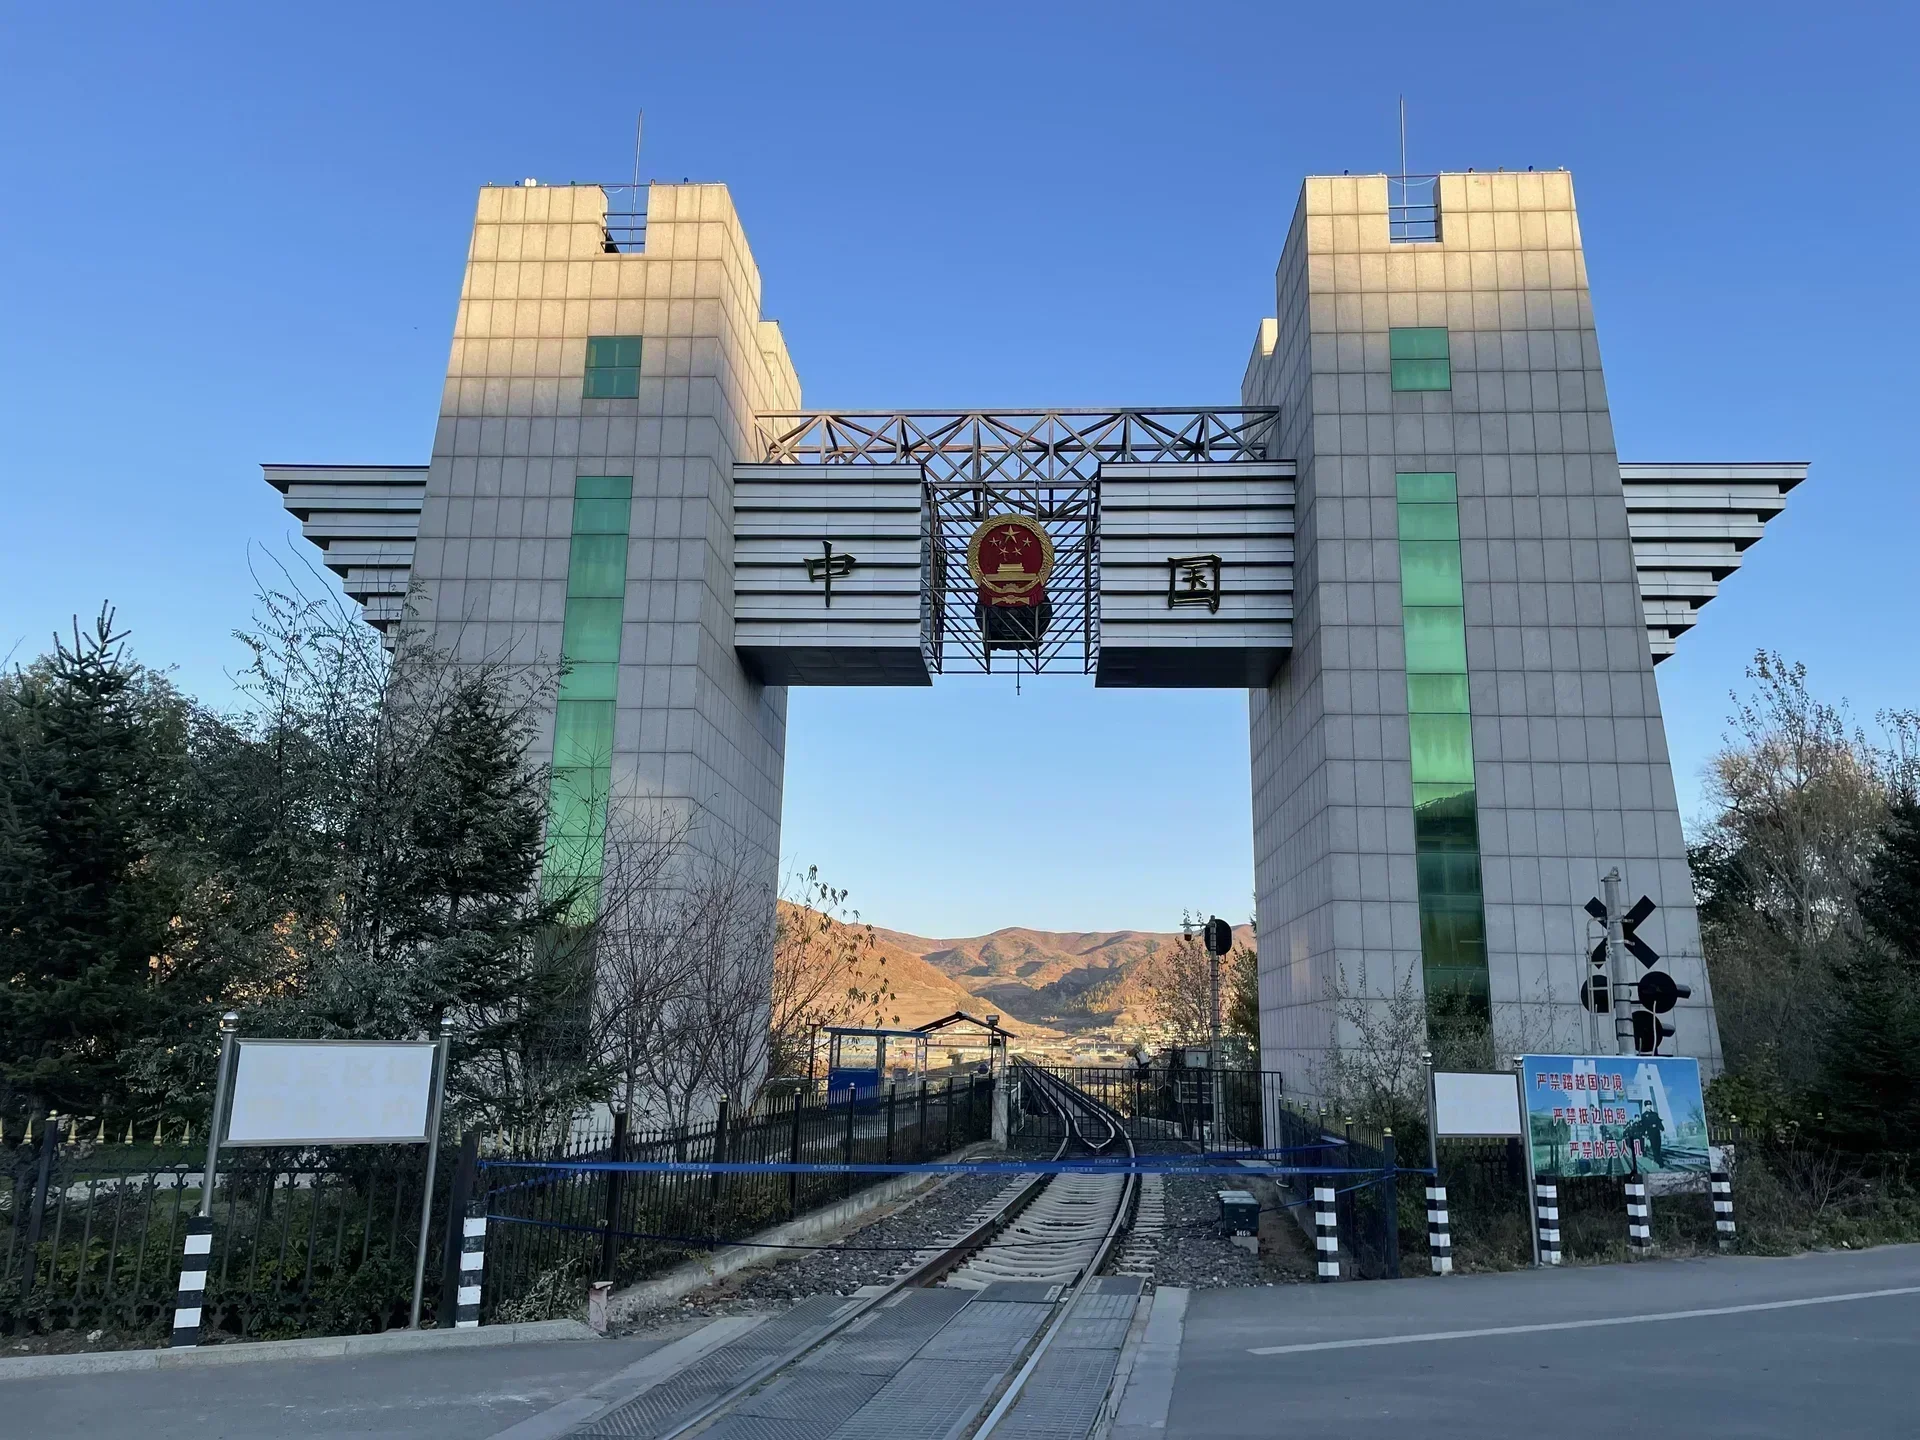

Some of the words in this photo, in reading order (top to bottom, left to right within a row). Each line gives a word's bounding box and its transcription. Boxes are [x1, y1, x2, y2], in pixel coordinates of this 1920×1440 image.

[802, 540, 857, 608] 中
[1167, 552, 1223, 615] 国
[1536, 1073, 1623, 1090] 严禁踏越国边境
[1553, 1108, 1627, 1126] 严禁抵边拍照
